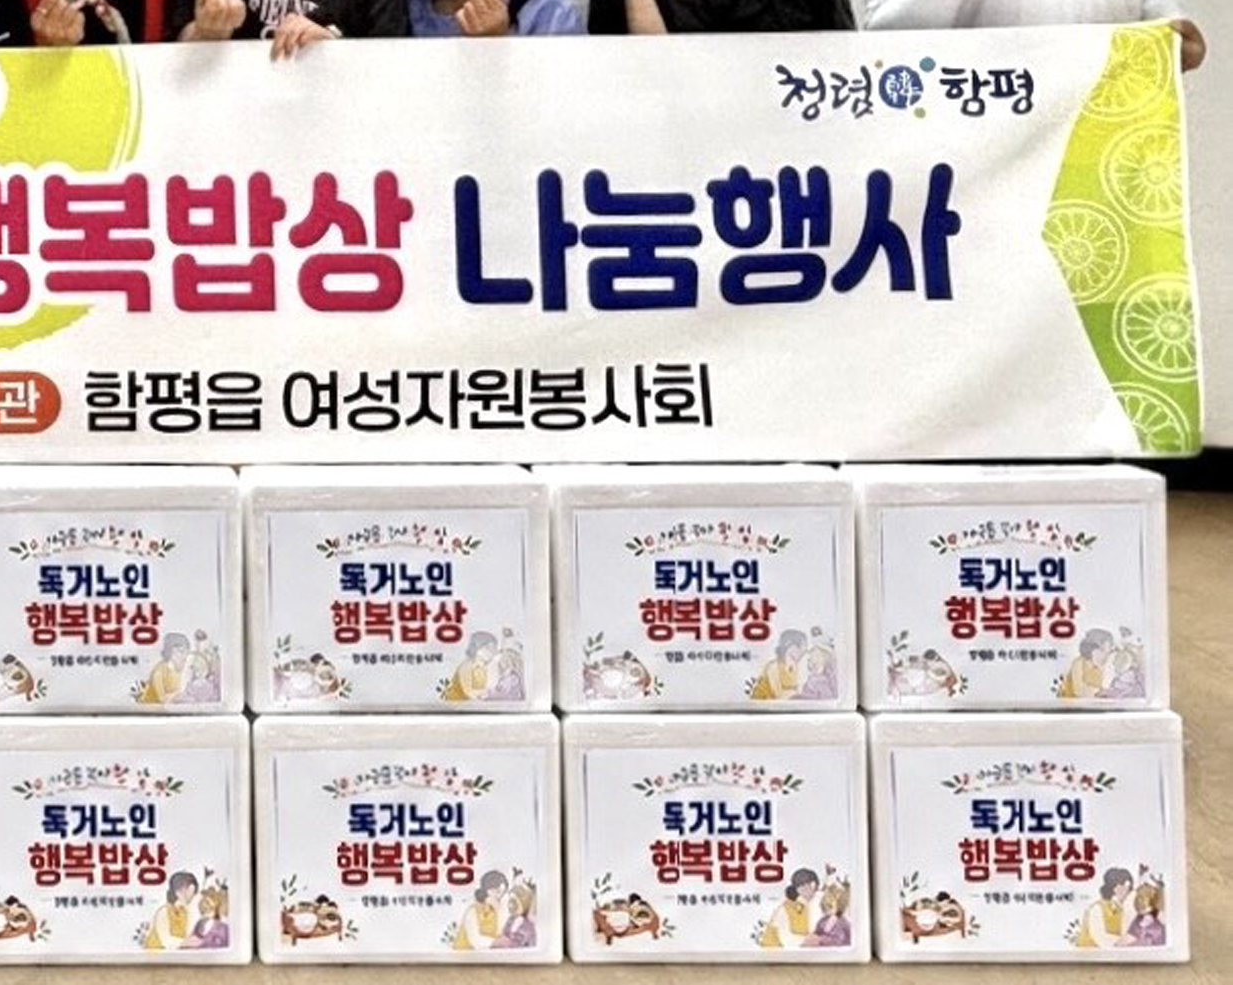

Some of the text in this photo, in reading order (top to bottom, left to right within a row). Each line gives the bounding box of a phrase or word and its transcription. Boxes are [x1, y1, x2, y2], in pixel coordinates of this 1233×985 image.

[775, 64, 873, 122] 청렴
[939, 67, 1034, 117] 함평
[454, 163, 961, 312] 나눔행사
[84, 371, 263, 434] 함평읍
[282, 363, 713, 432] 여성자원봉사회
[38, 564, 149, 599] 독거노인
[340, 562, 452, 597] 독거노인
[655, 560, 759, 594] 독거노인
[959, 558, 1066, 592] 독거노인
[24, 601, 163, 646] 행복밥상
[330, 600, 468, 644] 행복밥상
[639, 597, 777, 642] 행복밥상
[946, 595, 1080, 640] 행복밥상
[42, 804, 155, 839] 독거노인
[348, 803, 464, 838] 독거노인
[663, 801, 771, 836] 독거노인
[970, 799, 1081, 834] 독거노인
[27, 841, 169, 887] 행복밥상
[336, 841, 478, 887] 행복밥상
[649, 839, 787, 884] 행복밥상
[958, 838, 1100, 883] 행복밥상
